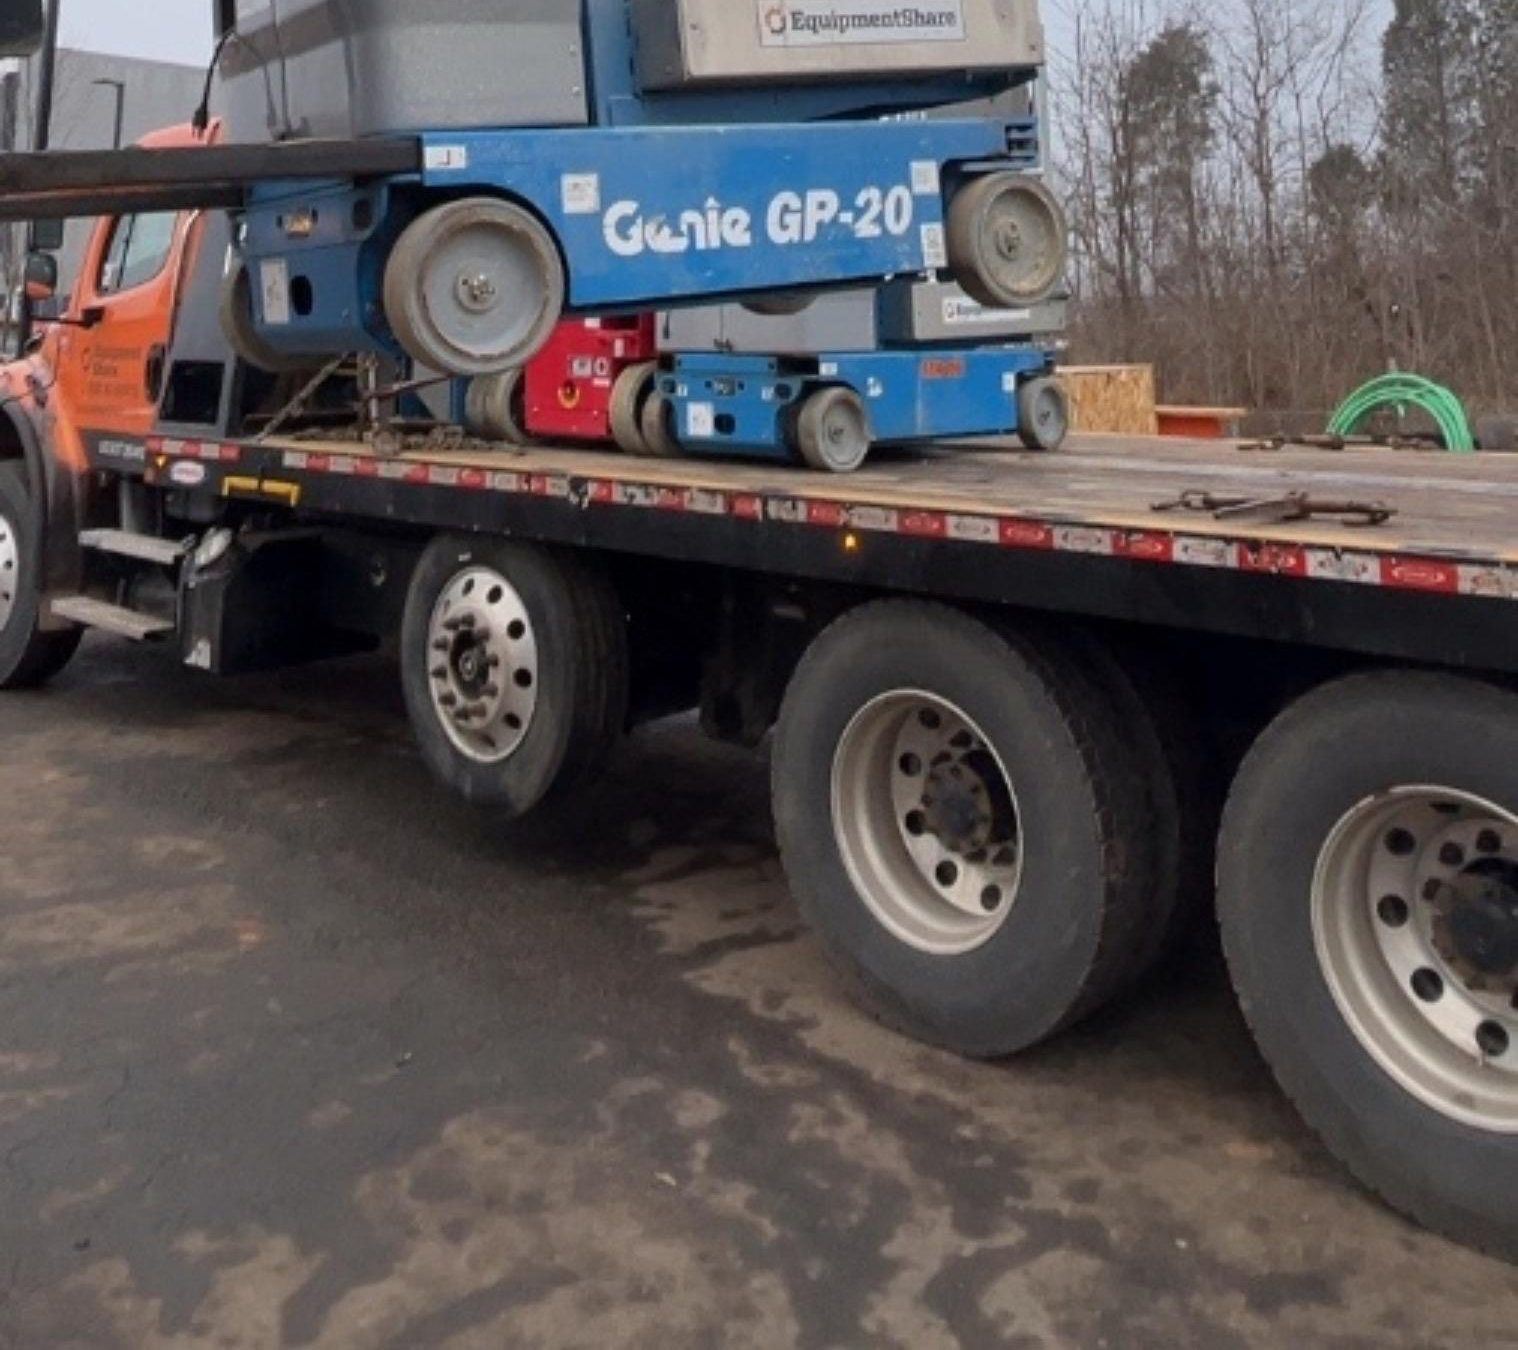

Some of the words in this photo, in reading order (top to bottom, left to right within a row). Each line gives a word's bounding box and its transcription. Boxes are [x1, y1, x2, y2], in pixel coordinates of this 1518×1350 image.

[790, 8, 958, 34] EquipmentShare
[602, 195, 751, 256] Genie
[766, 185, 913, 245] GP-20
